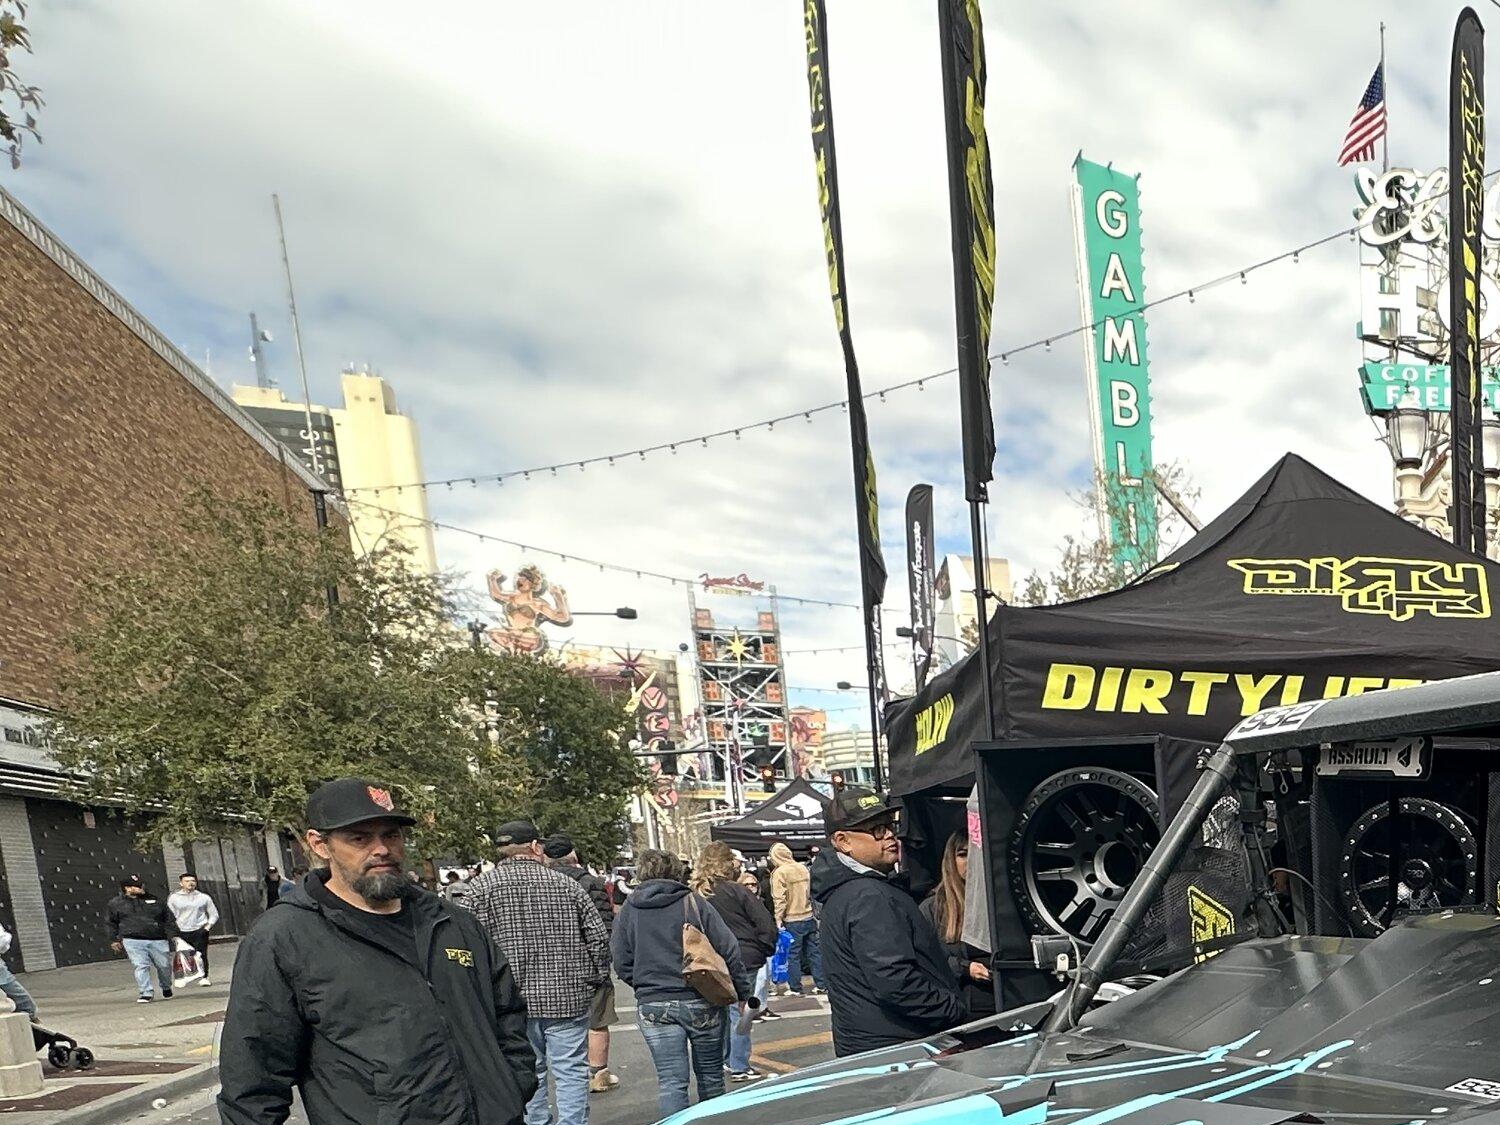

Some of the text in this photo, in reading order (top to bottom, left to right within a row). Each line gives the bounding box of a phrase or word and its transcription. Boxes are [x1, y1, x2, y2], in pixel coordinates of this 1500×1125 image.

[1359, 168, 1449, 246] El
[1041, 663, 1421, 716] DIRTYLI
[1238, 703, 1316, 733] 932
[1328, 747, 1391, 766] ASSAULT
